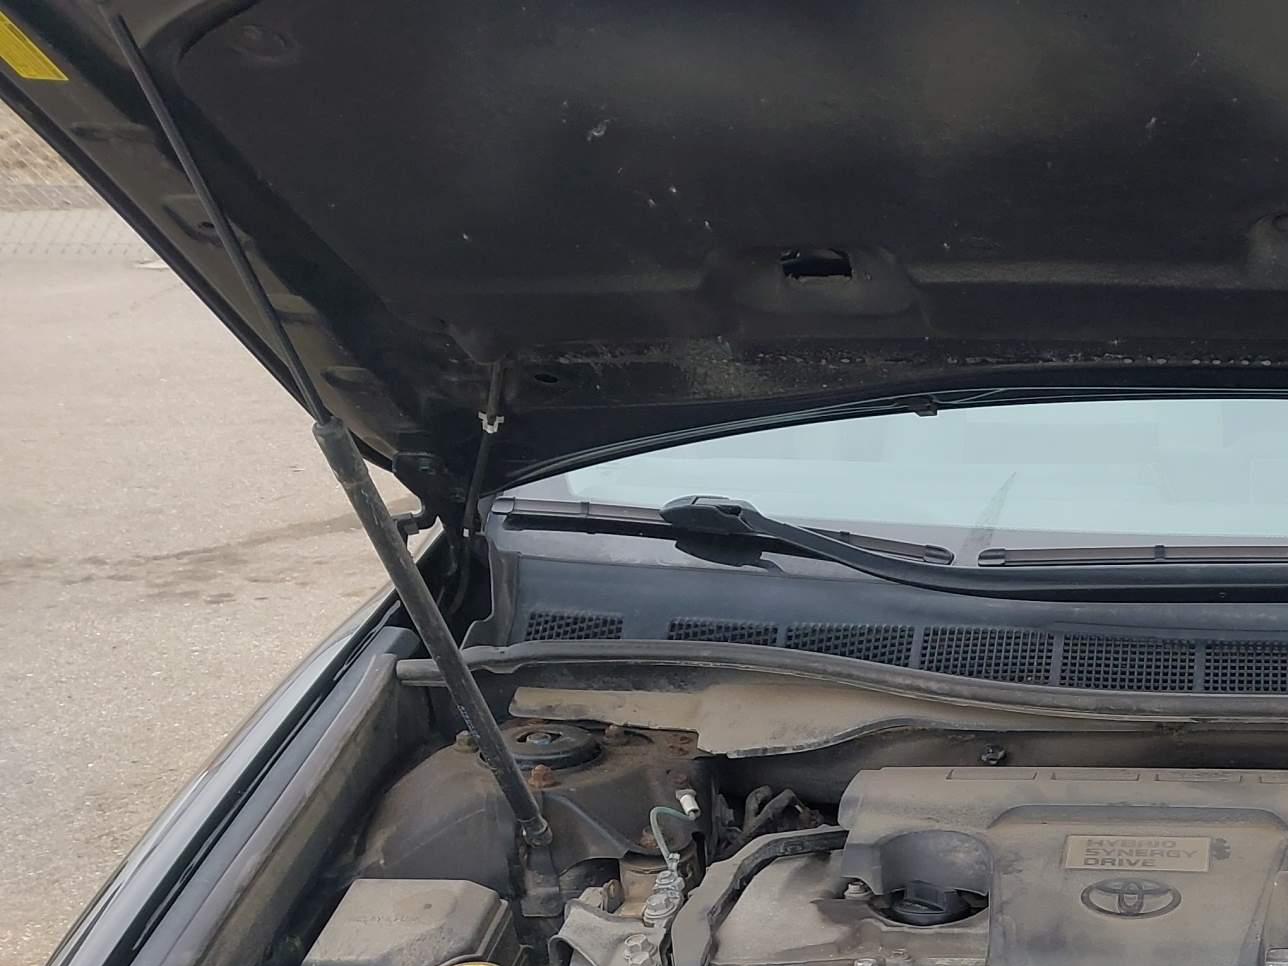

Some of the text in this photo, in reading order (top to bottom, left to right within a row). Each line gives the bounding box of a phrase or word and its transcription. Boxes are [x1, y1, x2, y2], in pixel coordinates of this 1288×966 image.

[1086, 838, 1177, 849] HYBRID
[1084, 848, 1199, 858] SYNERGY
[1083, 857, 1156, 867] DRIVE
